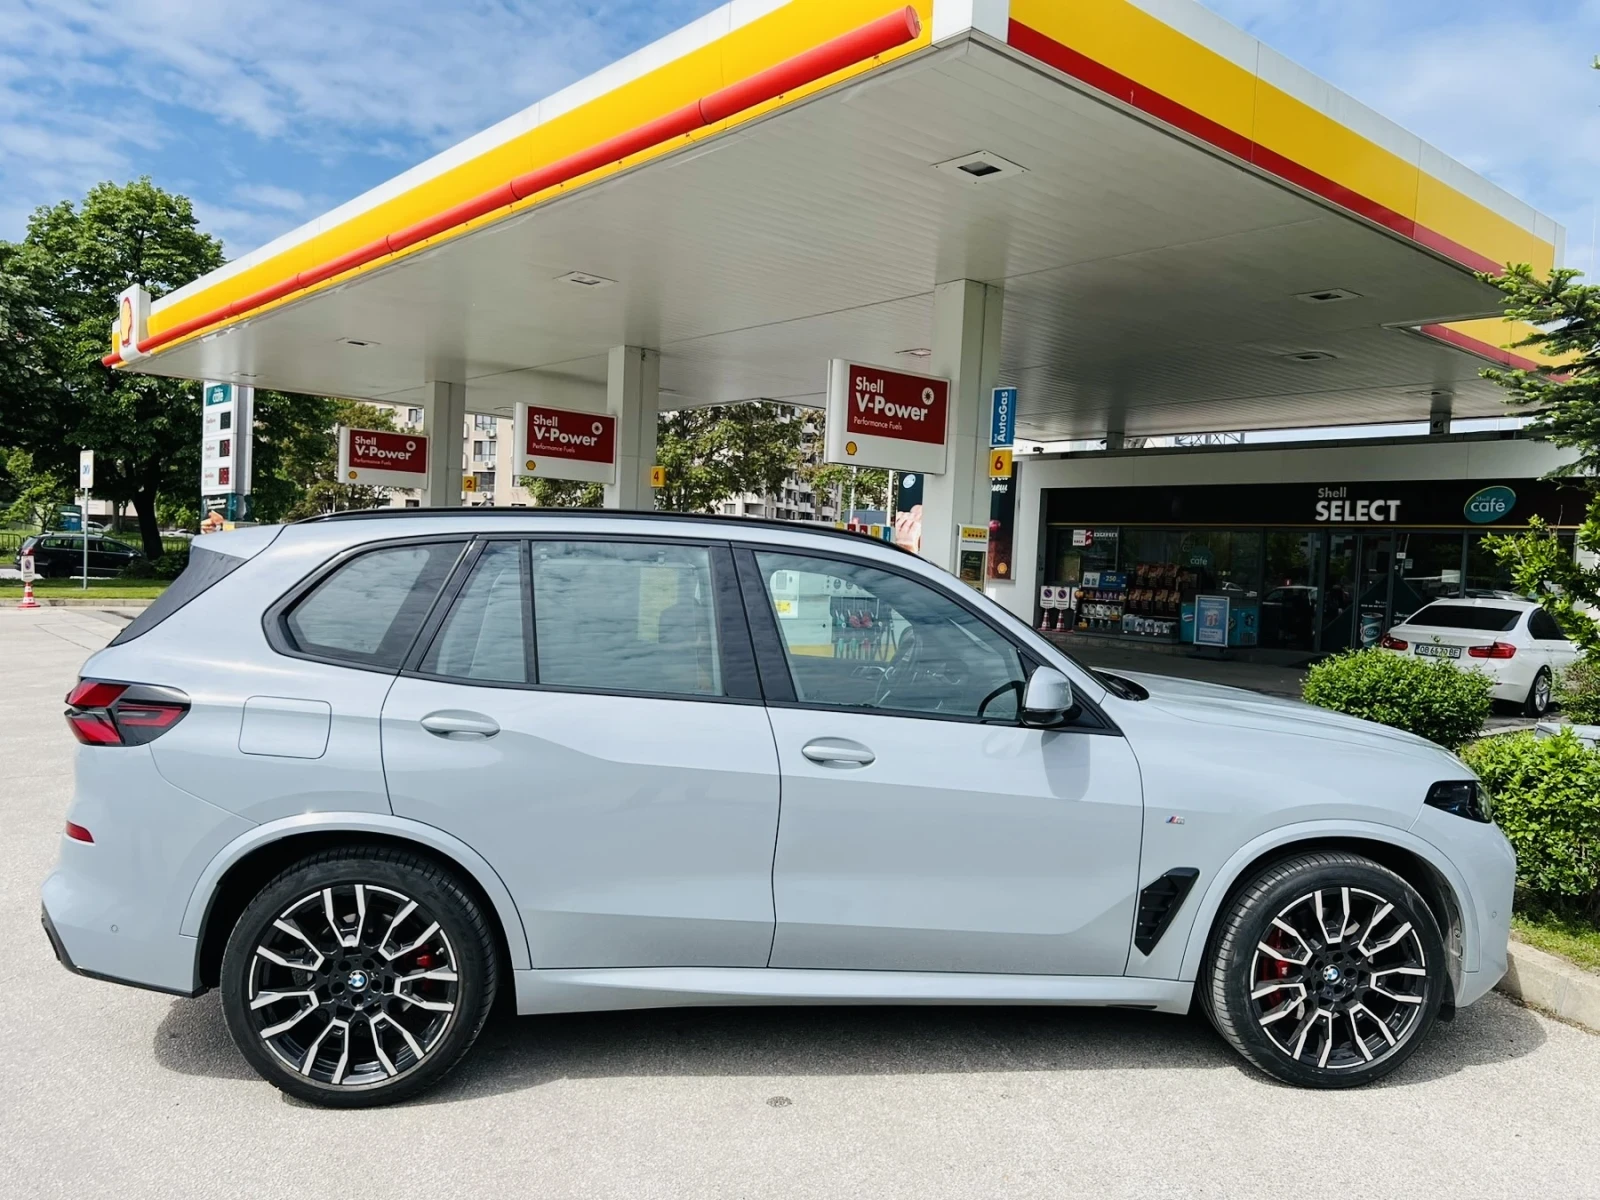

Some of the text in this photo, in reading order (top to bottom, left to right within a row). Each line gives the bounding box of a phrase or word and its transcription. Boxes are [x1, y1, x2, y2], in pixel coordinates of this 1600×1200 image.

[855, 376, 884, 394] Shell
[855, 392, 928, 422] V-Power
[533, 415, 558, 428] Shell
[853, 416, 903, 431] Performance Fuels
[997, 391, 1009, 442] AutoGas
[355, 435, 376, 446] Shell
[533, 426, 597, 447] V-Power
[355, 444, 411, 460] V-Power
[532, 442, 576, 454] Performance Fuels
[353, 457, 380, 465] Performance
[994, 456, 1004, 471] 6
[653, 471, 660, 482] 4
[466, 480, 472, 489] 2
[1317, 487, 1347, 498] Shell
[1315, 499, 1401, 522] SELECT
[1470, 497, 1506, 512] café
